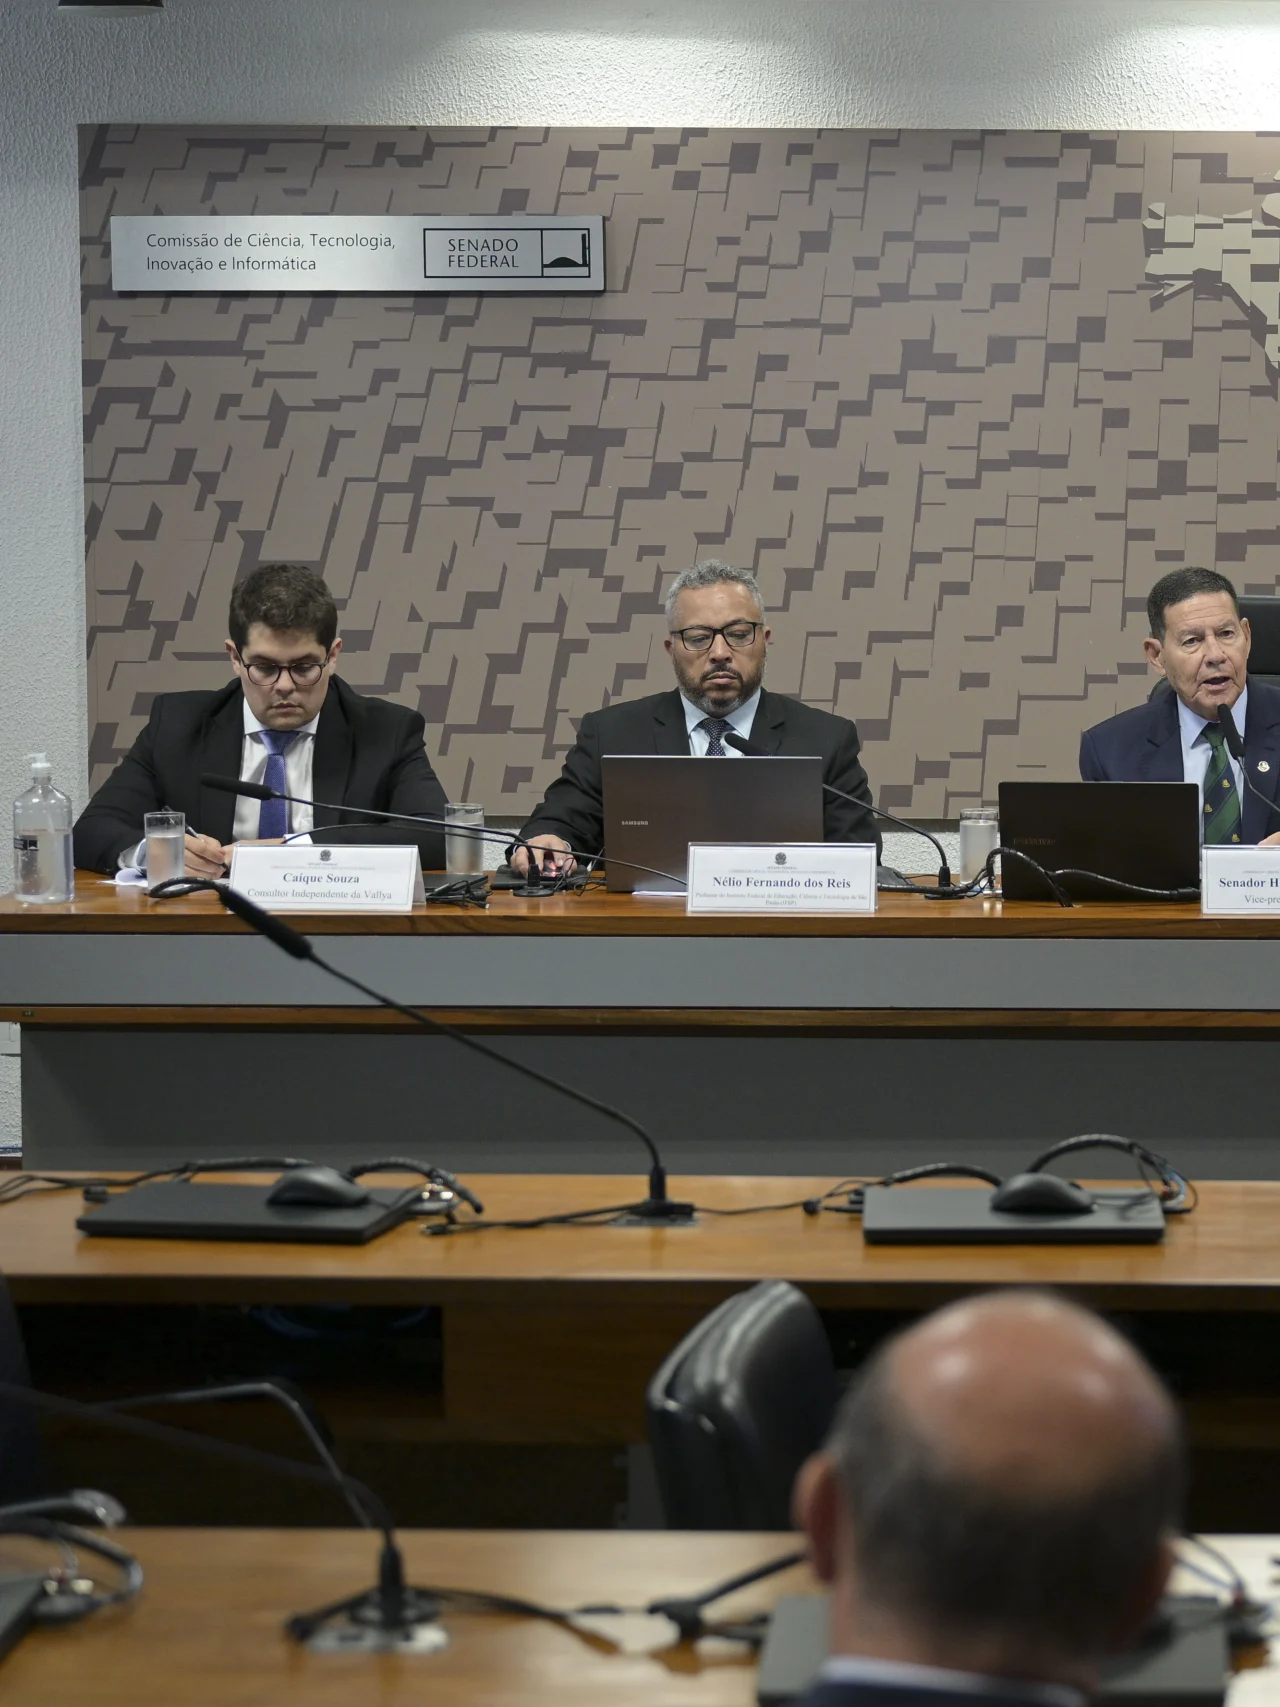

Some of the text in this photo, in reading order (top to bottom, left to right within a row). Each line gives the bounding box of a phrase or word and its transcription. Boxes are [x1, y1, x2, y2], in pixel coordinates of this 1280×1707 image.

[146, 232, 396, 251] Comissão de Ciência, Tecnologia,
[447, 237, 519, 252] SENADO
[146, 255, 316, 275] Inovação e Informática
[448, 254, 519, 269] FEDERAL
[283, 872, 360, 885] Caíque Souza
[713, 876, 851, 888] Nélio Fernando dos Reis
[1219, 877, 1266, 888] Senador
[247, 888, 289, 898] Consultor
[292, 889, 349, 901] Independente
[351, 890, 361, 899] da
